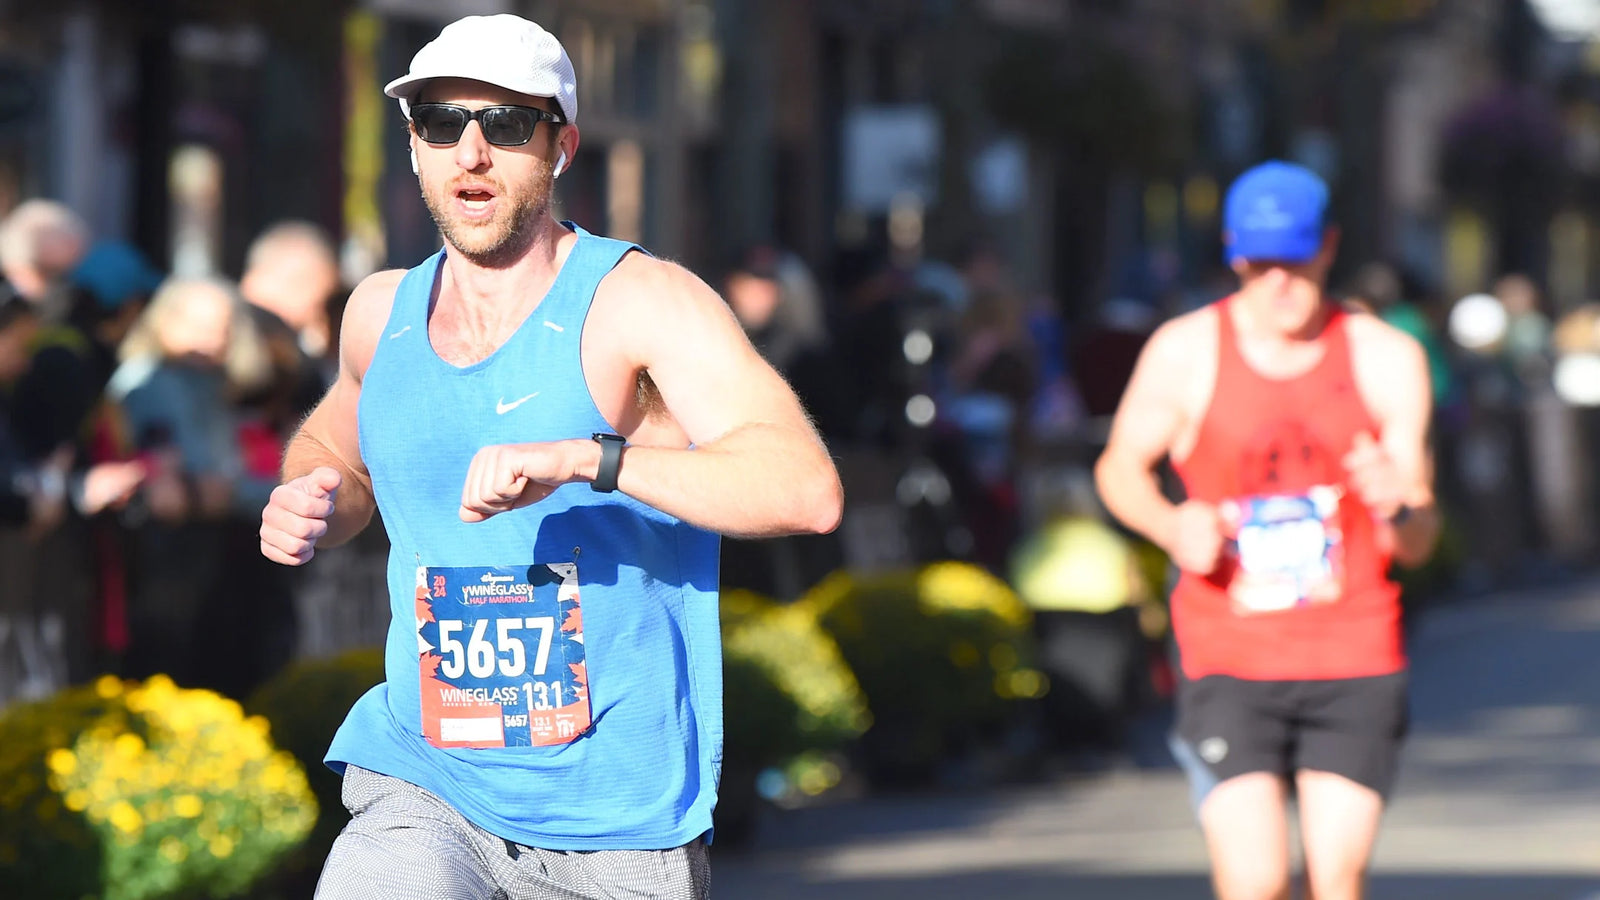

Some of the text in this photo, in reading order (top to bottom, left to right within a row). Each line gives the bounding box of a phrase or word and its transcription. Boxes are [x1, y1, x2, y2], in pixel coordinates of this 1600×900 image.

[434, 576, 445, 586] 20
[434, 587, 446, 597] 24
[468, 584, 527, 596] WINEGLASS
[489, 596, 528, 604] MARATHON
[439, 617, 554, 679] 5657
[440, 687, 518, 702] WINEGLASS
[523, 681, 563, 711] 13.1
[504, 714, 528, 727] 5657
[534, 717, 550, 726] 13.1
